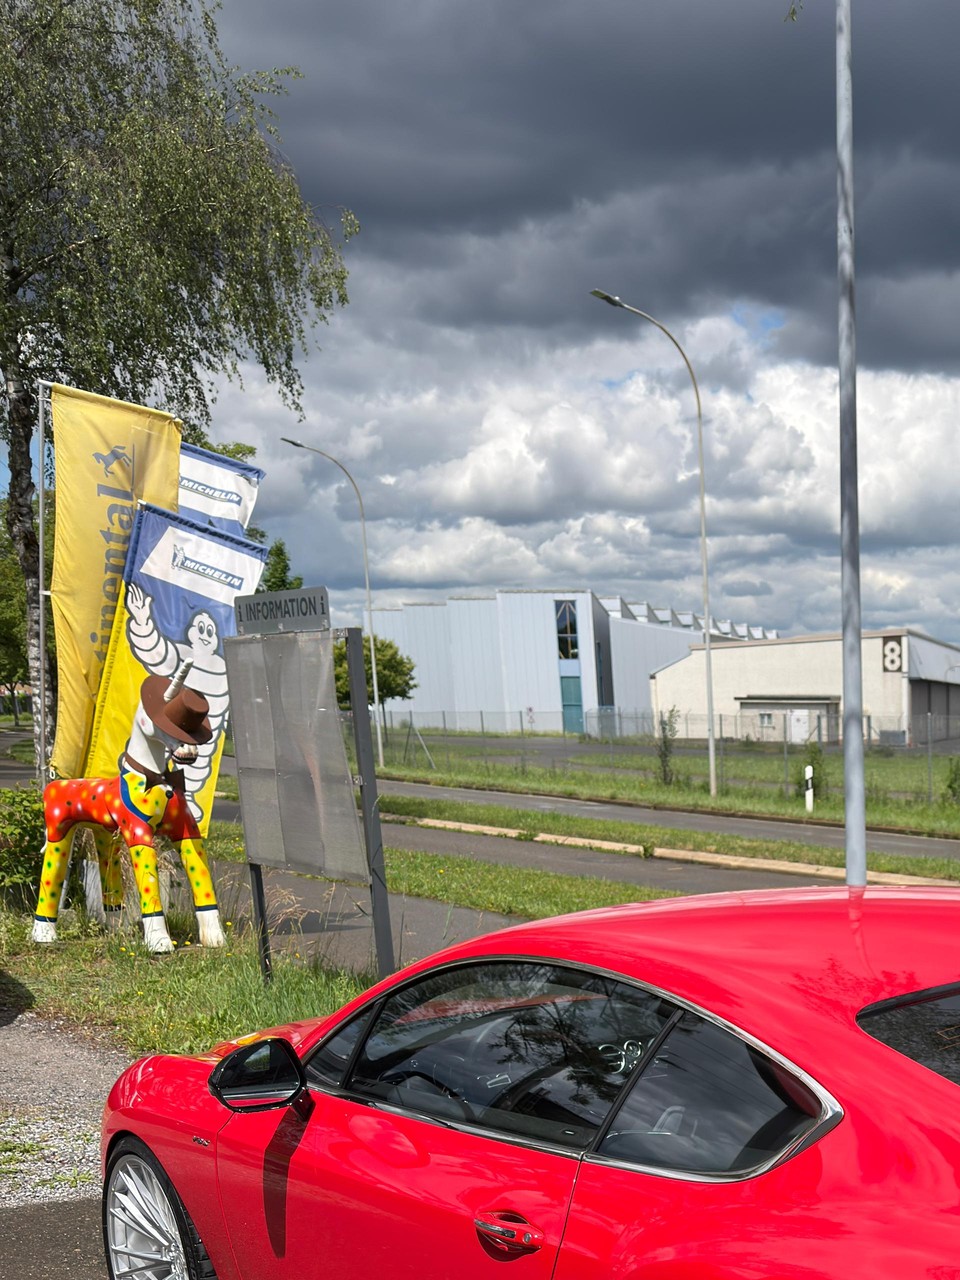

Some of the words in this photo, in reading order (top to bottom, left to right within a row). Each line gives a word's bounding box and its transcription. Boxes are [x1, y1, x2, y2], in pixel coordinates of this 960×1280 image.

[180, 479, 241, 502] MICHELIN
[90, 483, 134, 672] tinental
[183, 559, 242, 587] MICHELIN
[245, 596, 317, 621] INFORMATION
[884, 641, 901, 671] 8
